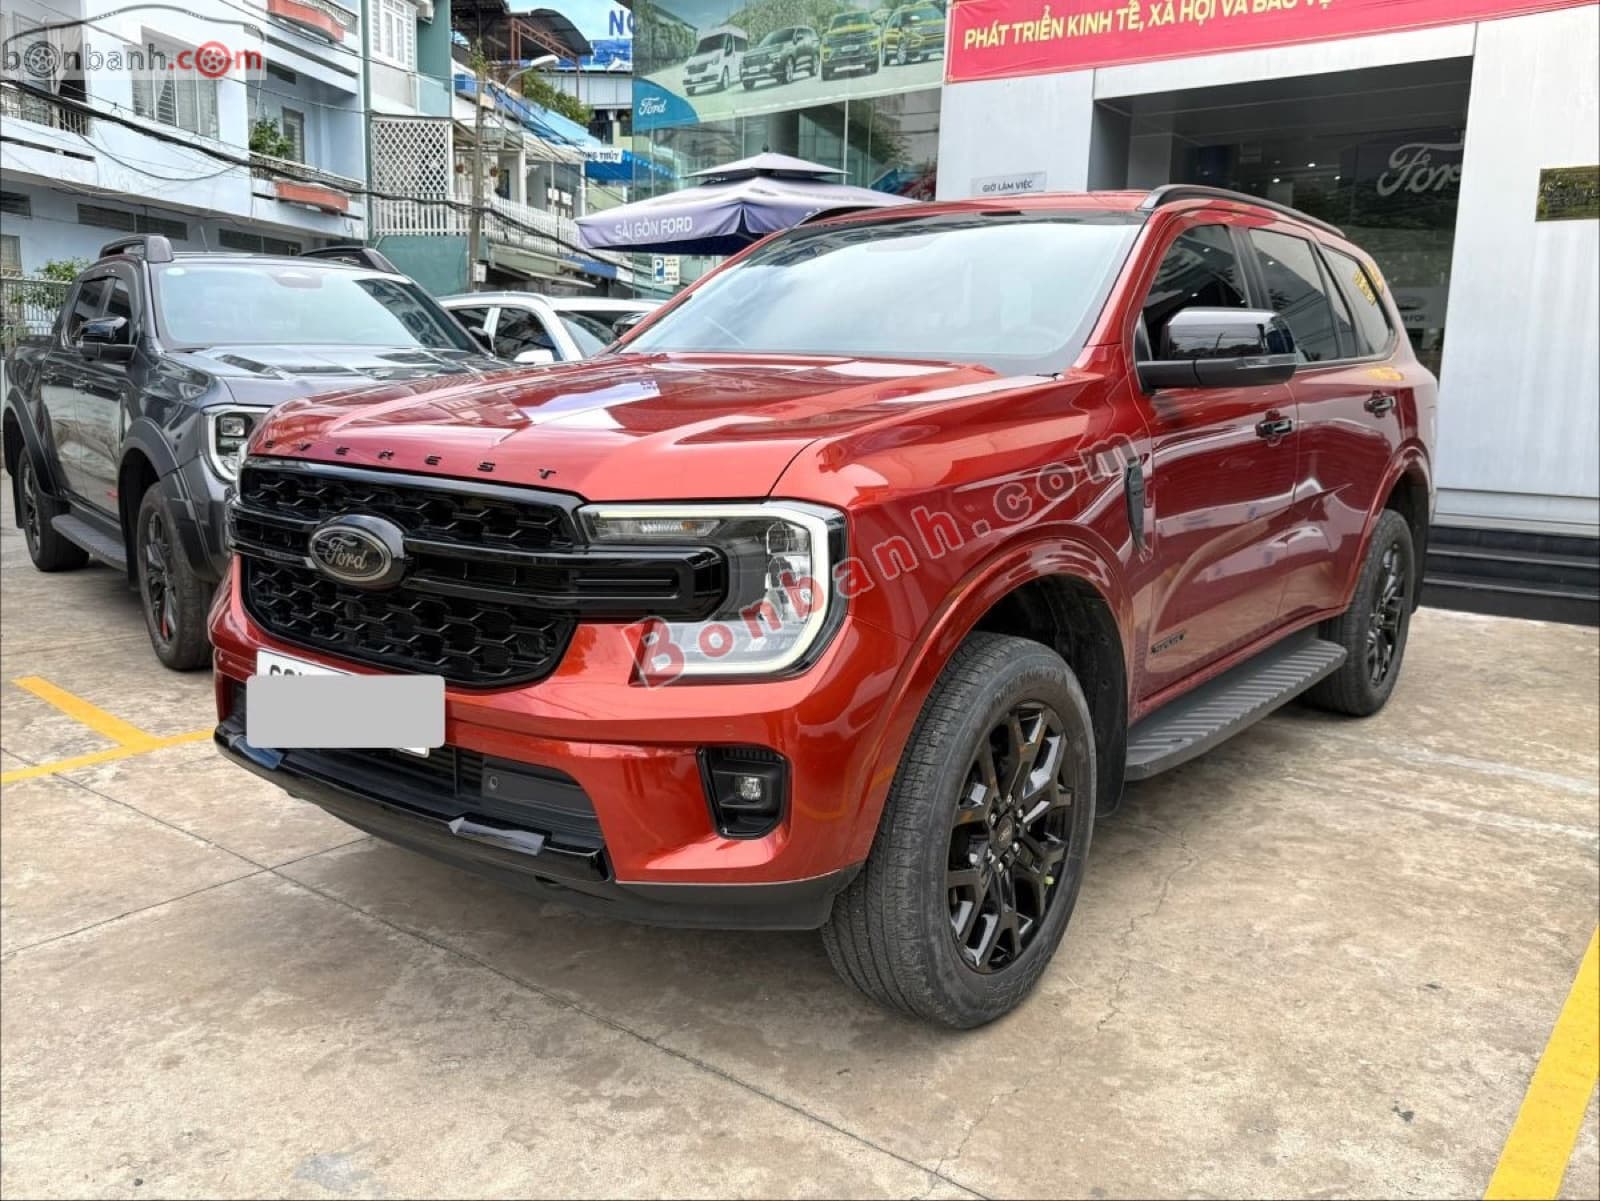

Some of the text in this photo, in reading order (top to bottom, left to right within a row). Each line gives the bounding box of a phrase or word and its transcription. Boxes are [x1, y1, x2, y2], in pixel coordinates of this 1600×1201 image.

[963, 19, 1010, 50] PHÁT
[1011, 4, 1064, 45] TRIỂN
[1067, 10, 1112, 37] KINH
[638, 96, 667, 116] Ford
[634, 215, 659, 238] GÒN
[660, 215, 693, 236] FORD
[264, 440, 557, 480] EVEREST
[325, 536, 368, 570] Ford
